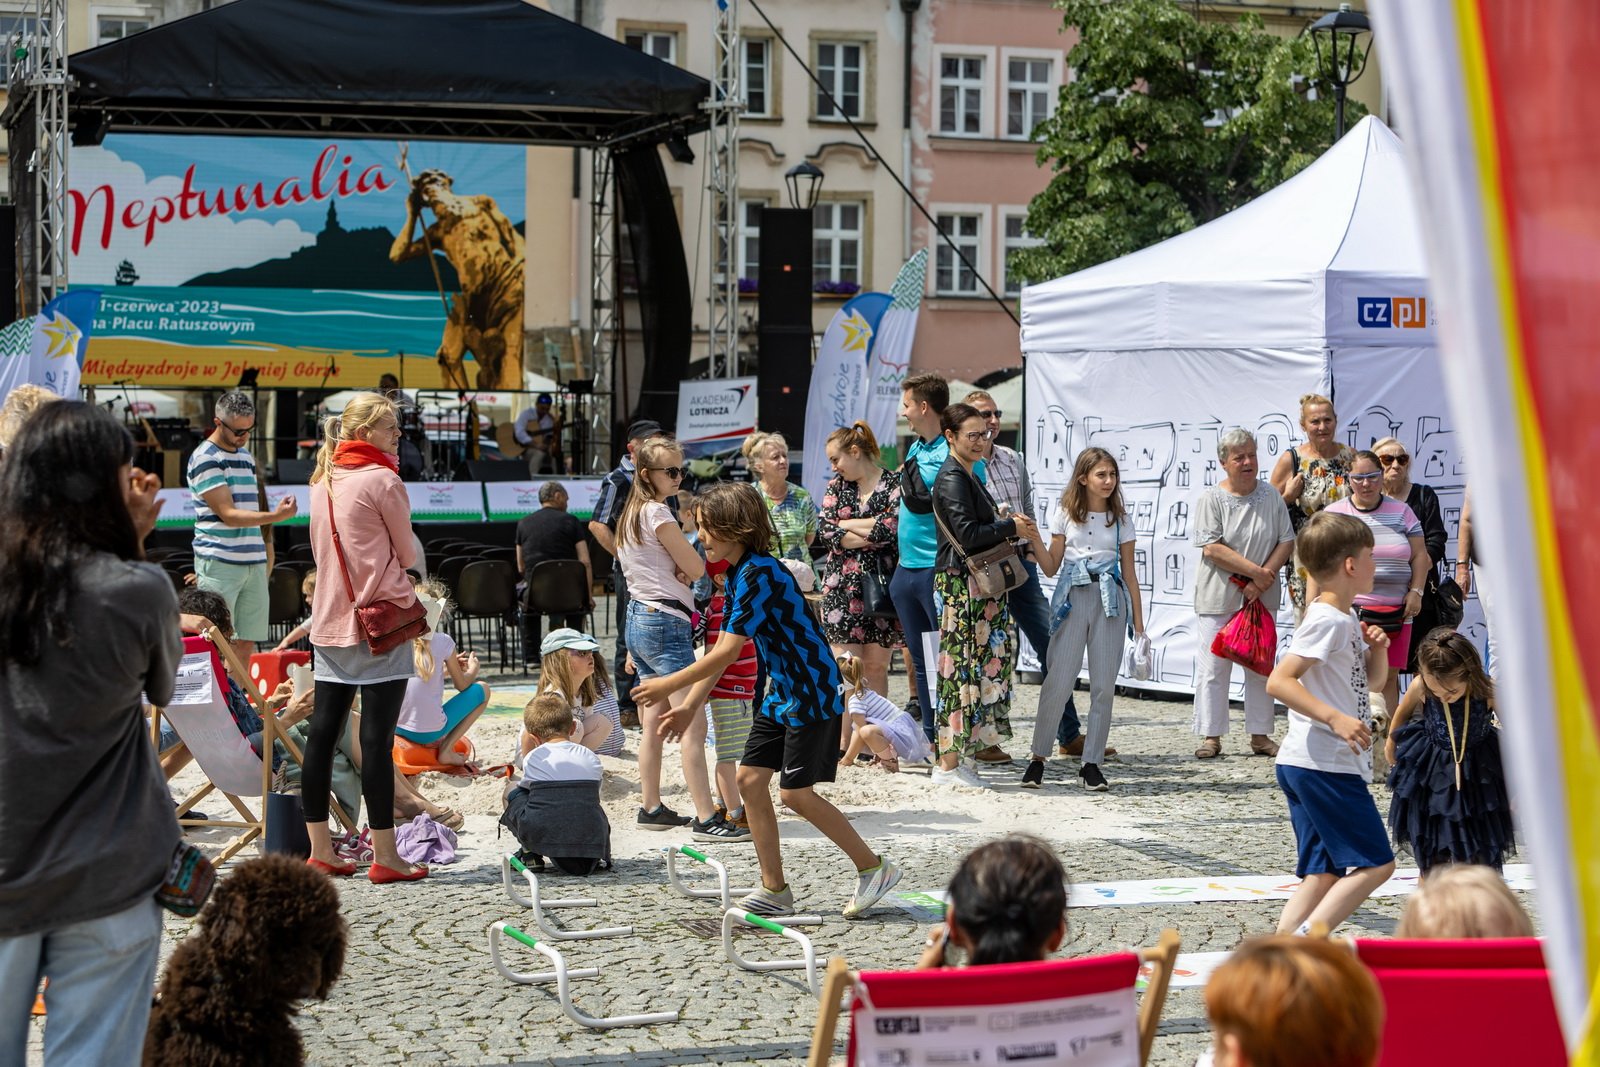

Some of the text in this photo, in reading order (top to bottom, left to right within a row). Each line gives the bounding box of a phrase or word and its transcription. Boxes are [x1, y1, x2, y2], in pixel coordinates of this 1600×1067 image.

[180, 300, 220, 314] 2023
[112, 316, 154, 330] Placu
[159, 317, 256, 335] Ratuszowym
[82, 358, 199, 380] Międzyzdroje
[203, 365, 217, 375] w
[221, 360, 289, 381] Jelniej
[690, 394, 736, 406] AKADEMIA
[689, 407, 729, 417] LOTNICZA
